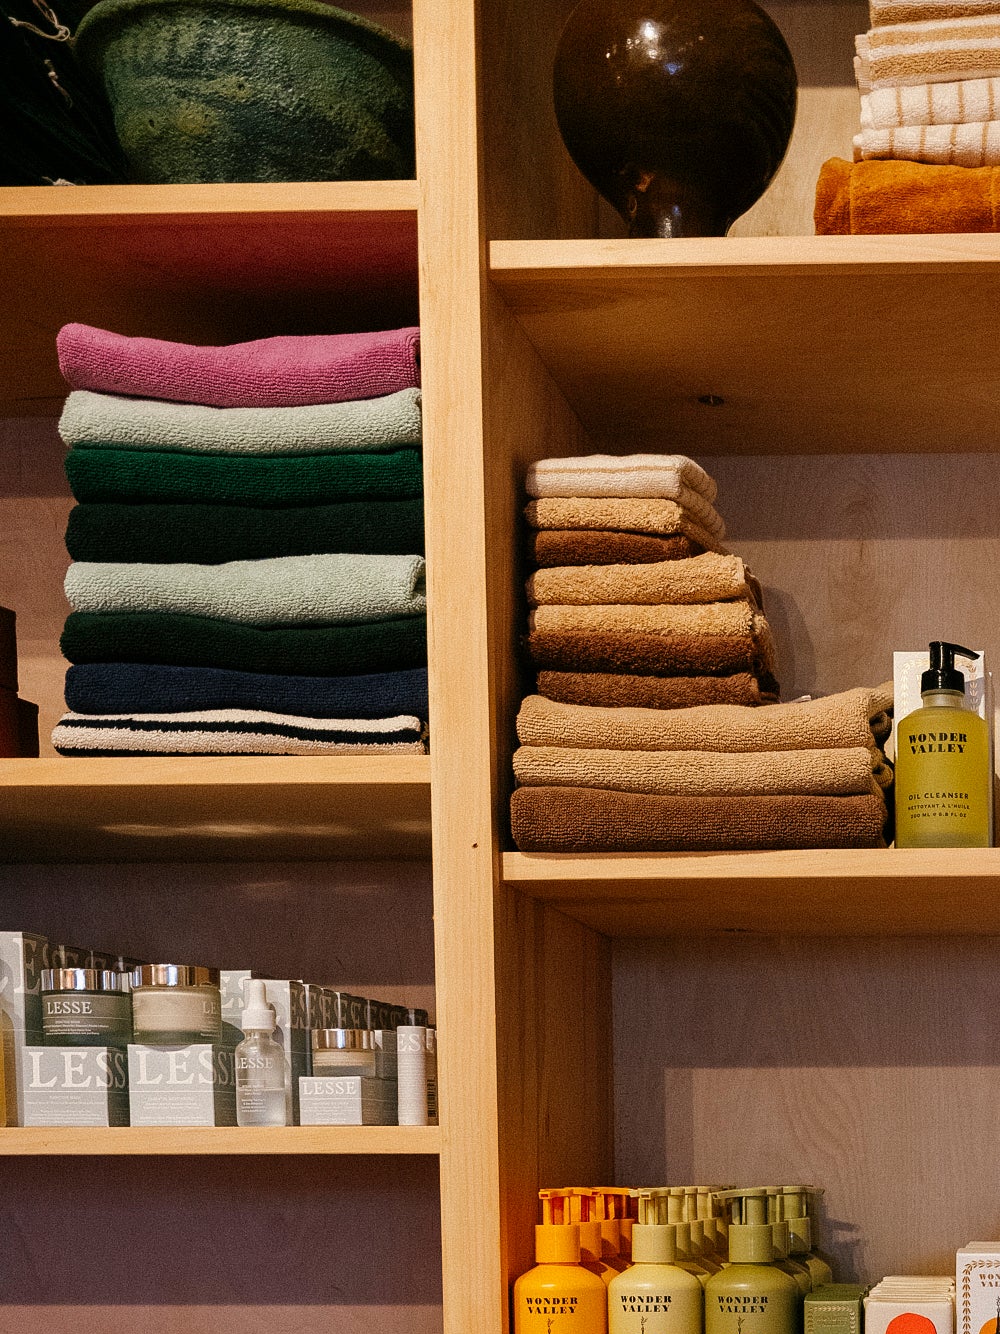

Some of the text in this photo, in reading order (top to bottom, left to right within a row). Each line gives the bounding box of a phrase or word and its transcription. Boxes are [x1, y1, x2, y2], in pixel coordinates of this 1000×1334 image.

[909, 732, 967, 744] WONDER
[911, 743, 966, 755] VALLEY
[908, 792, 969, 801] OIL CLEANSER
[47, 1001, 93, 1015] LESSE
[302, 1081, 357, 1095] LESSE
[526, 1297, 579, 1305] WONDER
[621, 1295, 673, 1304] WONDER
[718, 1296, 769, 1304] WONDER
[528, 1306, 577, 1314] VALLEY
[622, 1304, 670, 1313] VALLEY
[719, 1305, 767, 1313] VALLEY
